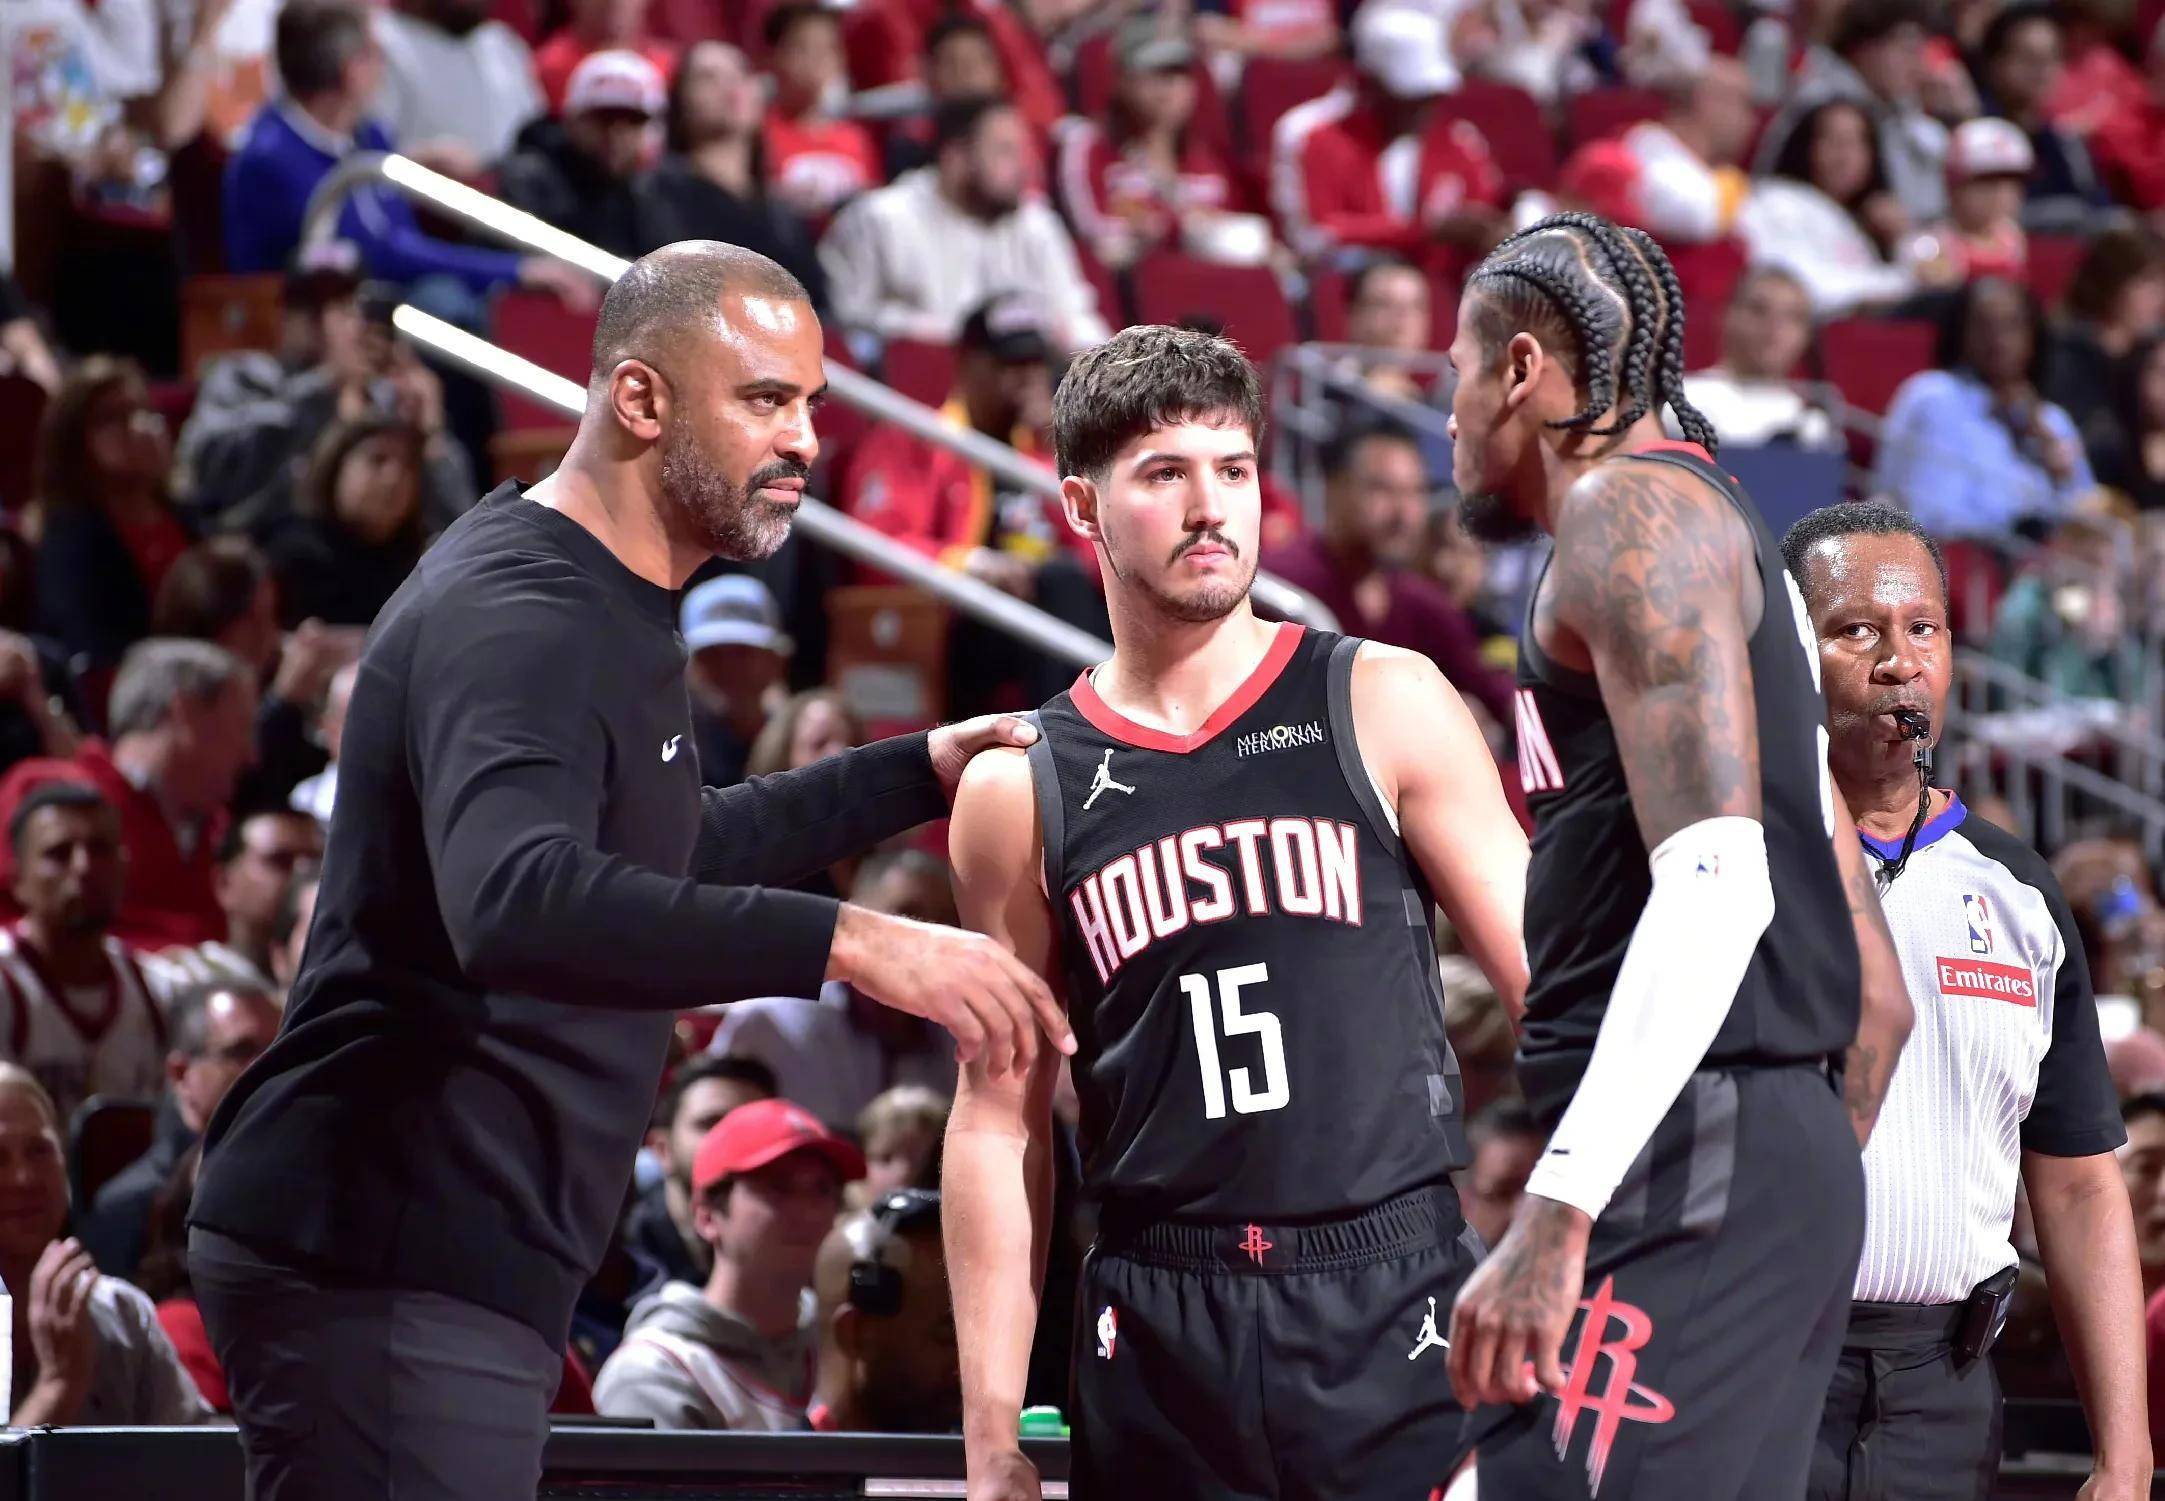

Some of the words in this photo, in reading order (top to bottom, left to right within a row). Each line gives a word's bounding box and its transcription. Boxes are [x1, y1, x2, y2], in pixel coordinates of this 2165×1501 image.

[1237, 720, 1322, 747] MEMORIAL
[1238, 729, 1323, 757] HERMANN
[1070, 816, 1363, 986] HOUSTON
[1940, 965, 2033, 997] Emirates
[1179, 962, 1290, 1119] 15
